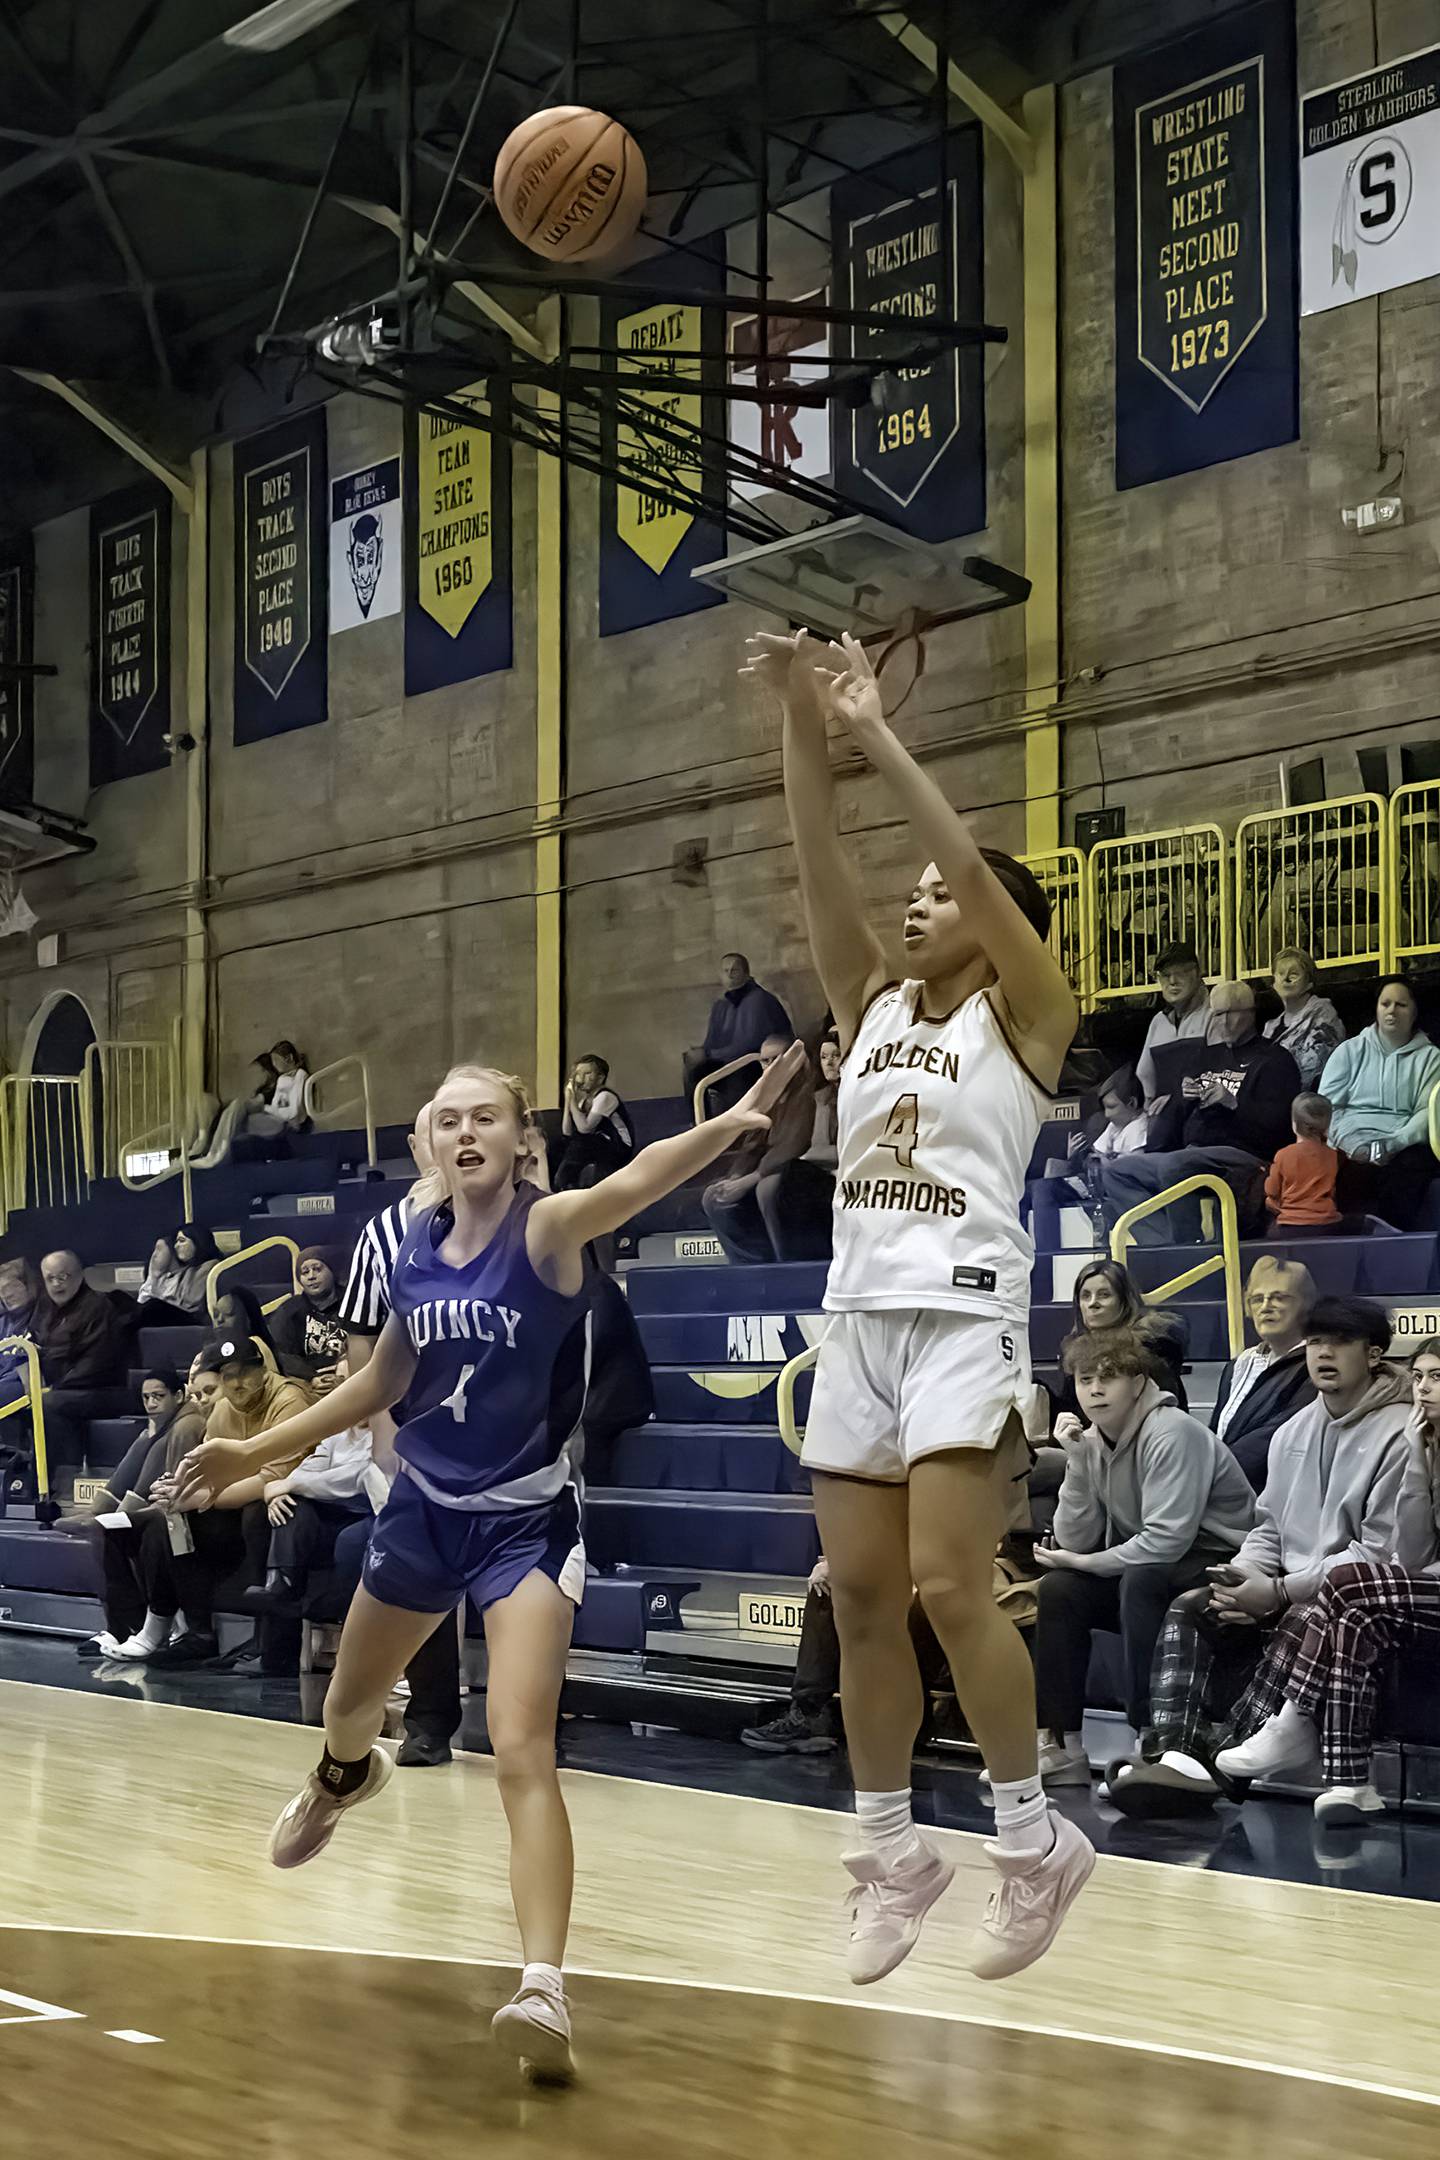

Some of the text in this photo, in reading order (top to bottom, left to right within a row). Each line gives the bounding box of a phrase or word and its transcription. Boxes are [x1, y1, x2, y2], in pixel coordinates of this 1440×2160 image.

[1338, 70, 1404, 112] STERLING
[1152, 83, 1246, 145] WRESTLING
[1309, 84, 1438, 148] GOLDEN WARRIORS
[1166, 131, 1229, 186] STATE
[1172, 179, 1227, 231] MEET
[1360, 151, 1397, 229] S
[1159, 221, 1240, 280] SECOND
[1166, 270, 1234, 324] PLACE
[630, 309, 684, 351] DEBATE
[1171, 319, 1230, 373] 1973
[878, 403, 932, 454] 1964
[438, 440, 470, 476] TEAM
[262, 471, 292, 506] BOYS
[434, 477, 473, 515] STATE
[257, 506, 295, 543] TRACK
[420, 511, 489, 558] CHAMPIONS
[255, 543, 297, 580] SECOND
[435, 556, 473, 596] 1960
[259, 578, 294, 615] PLACE
[111, 633, 141, 666] PLACE
[877, 1093, 919, 1169] 4
[842, 1179, 967, 1218] WARRIORS
[983, 1275, 993, 1286] M
[1000, 1334, 1015, 1362] S
